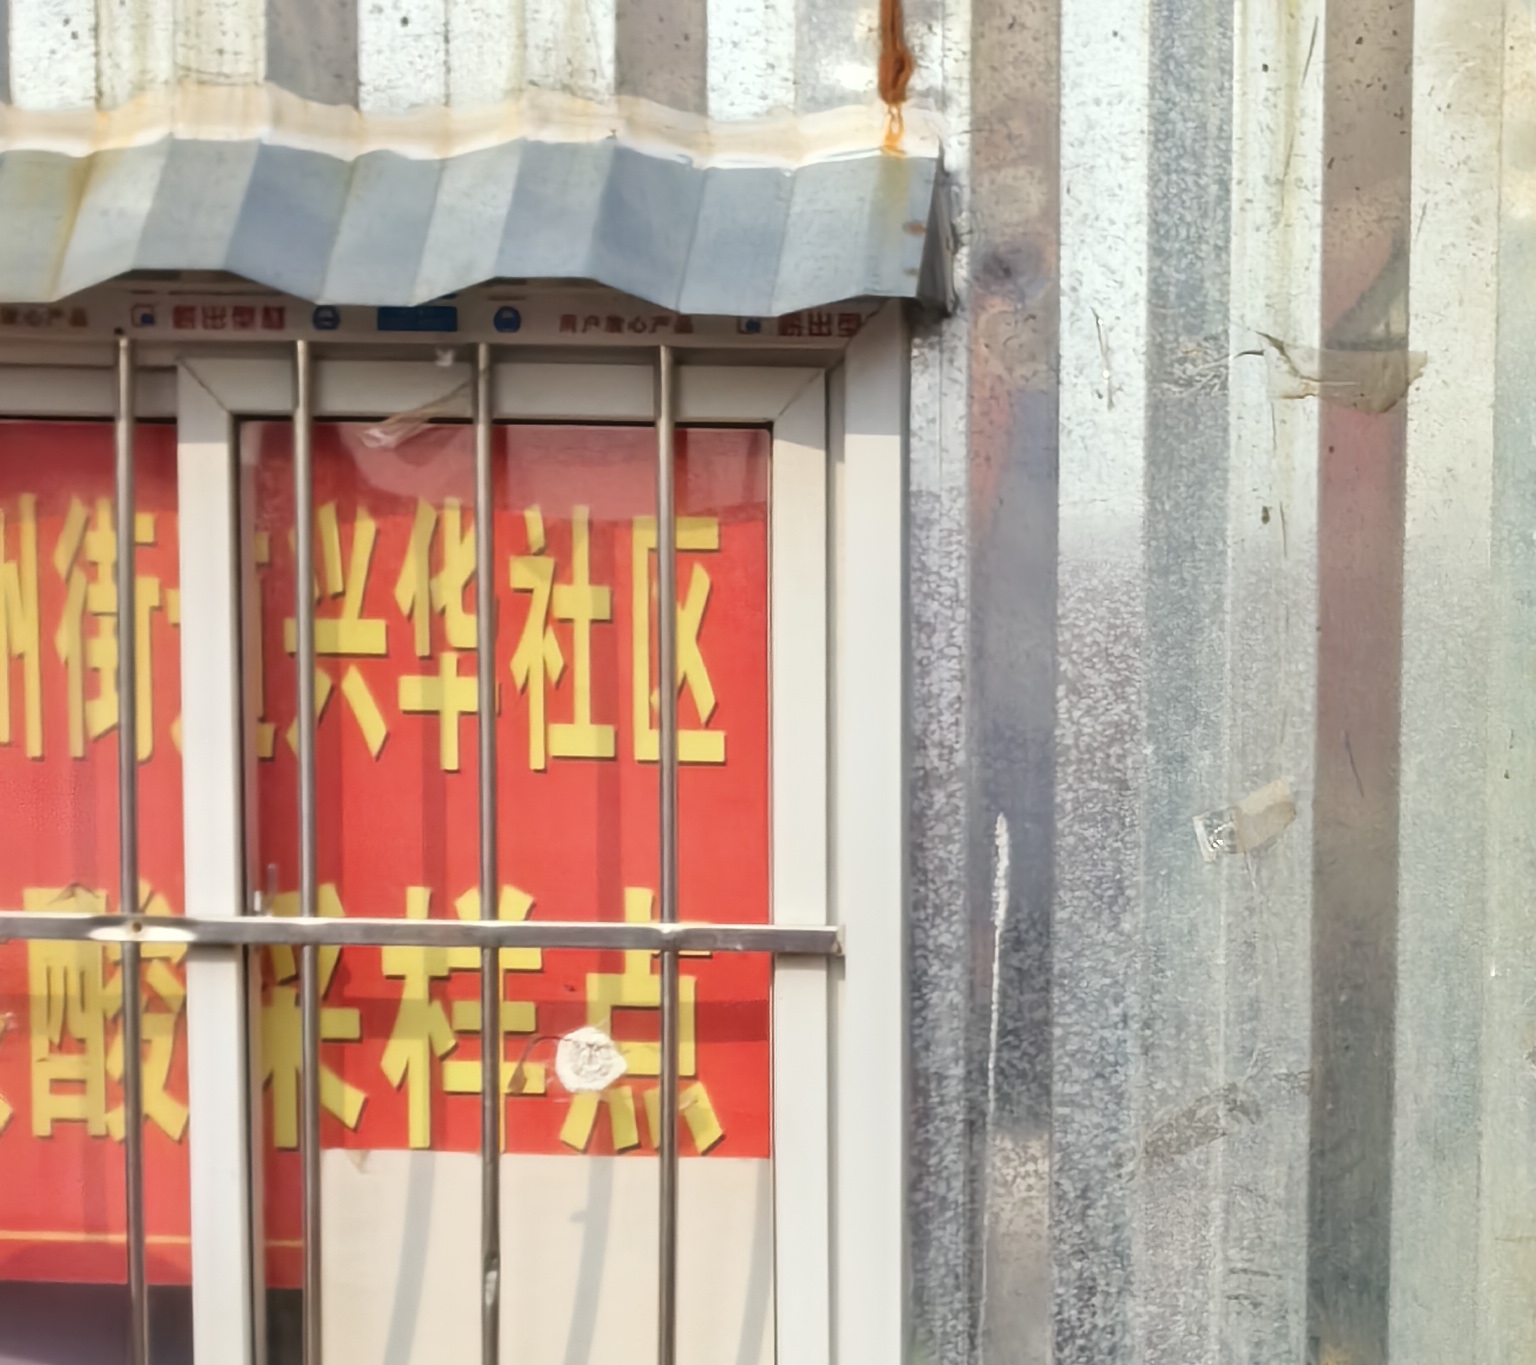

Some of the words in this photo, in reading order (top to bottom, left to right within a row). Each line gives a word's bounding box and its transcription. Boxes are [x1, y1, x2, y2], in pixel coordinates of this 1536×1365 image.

[0, 493, 726, 773] 州街兴华社区
[0, 880, 725, 1154] 酸采样点
